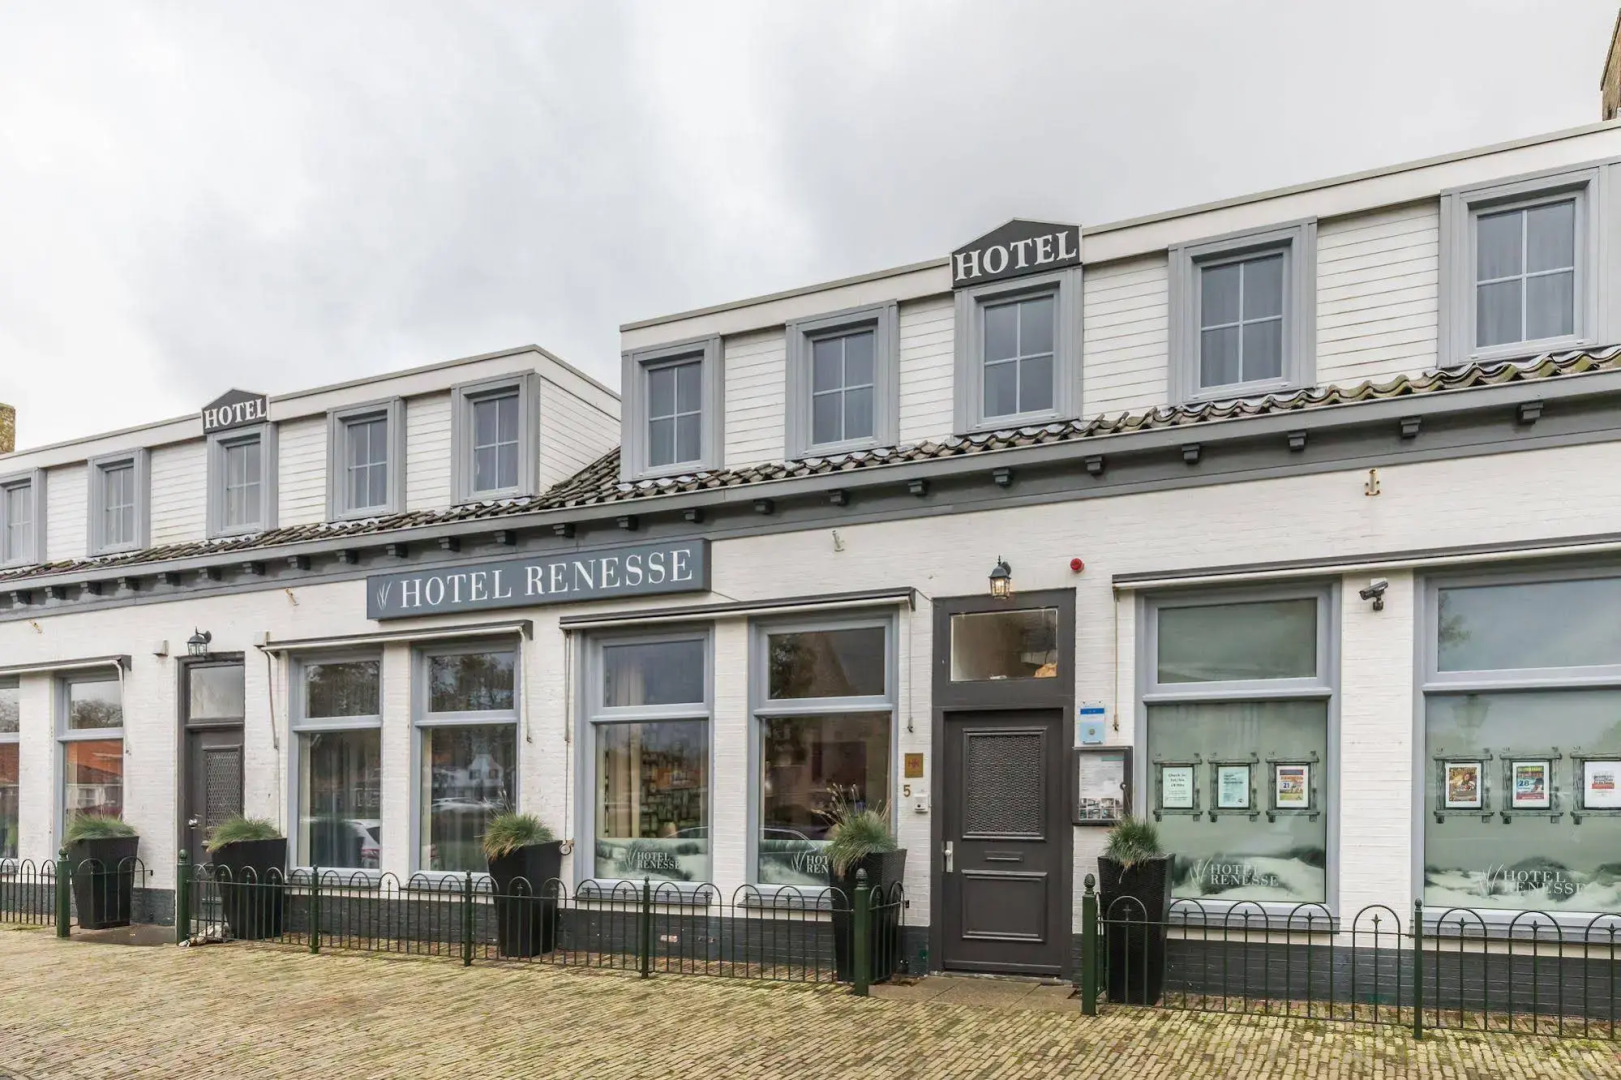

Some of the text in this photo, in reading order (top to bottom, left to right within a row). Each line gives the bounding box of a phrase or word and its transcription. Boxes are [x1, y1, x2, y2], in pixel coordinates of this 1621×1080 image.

[953, 230, 1077, 281] HOTEL
[203, 399, 267, 429] HOTEL
[400, 549, 693, 608] HOTEL RENESSE
[903, 784, 911, 797] 5
[637, 851, 671, 861] HOTEL
[806, 855, 828, 865] HOT
[637, 860, 681, 870] RENESSE
[1211, 864, 1262, 876] HOTEL
[1211, 874, 1279, 887] RENESSE
[1504, 870, 1566, 883] HOTEL
